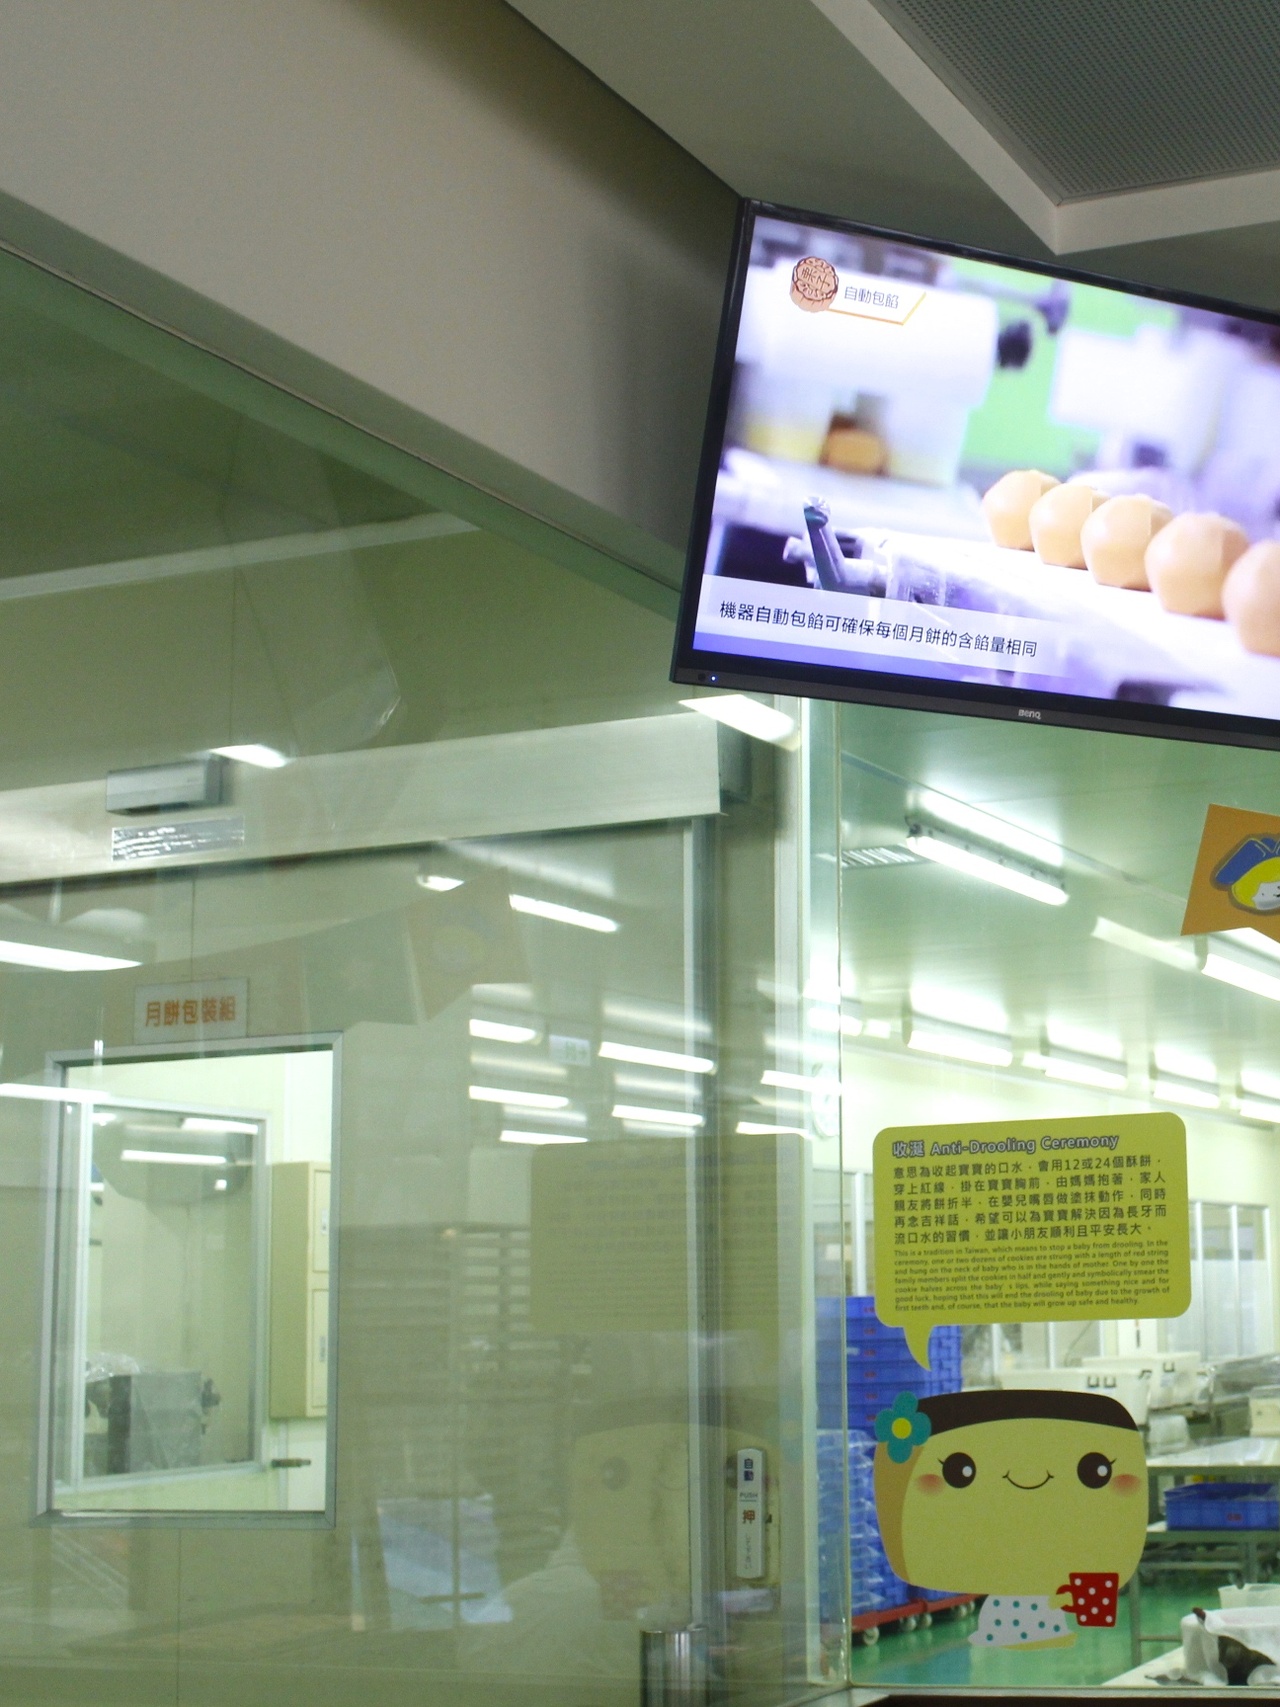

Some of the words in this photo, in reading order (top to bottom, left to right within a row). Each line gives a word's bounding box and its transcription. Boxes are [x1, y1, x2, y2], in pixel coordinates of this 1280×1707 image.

[844, 286, 899, 309] 自動包餡
[719, 601, 1038, 658] 機器自動包餡可確保每個月餅的含餡量相同
[145, 995, 236, 1028] 月餅包裝組
[892, 1139, 924, 1158] 收涎
[930, 1136, 1035, 1157] Anti-Drooling
[1040, 1132, 1119, 1152] Ceremony
